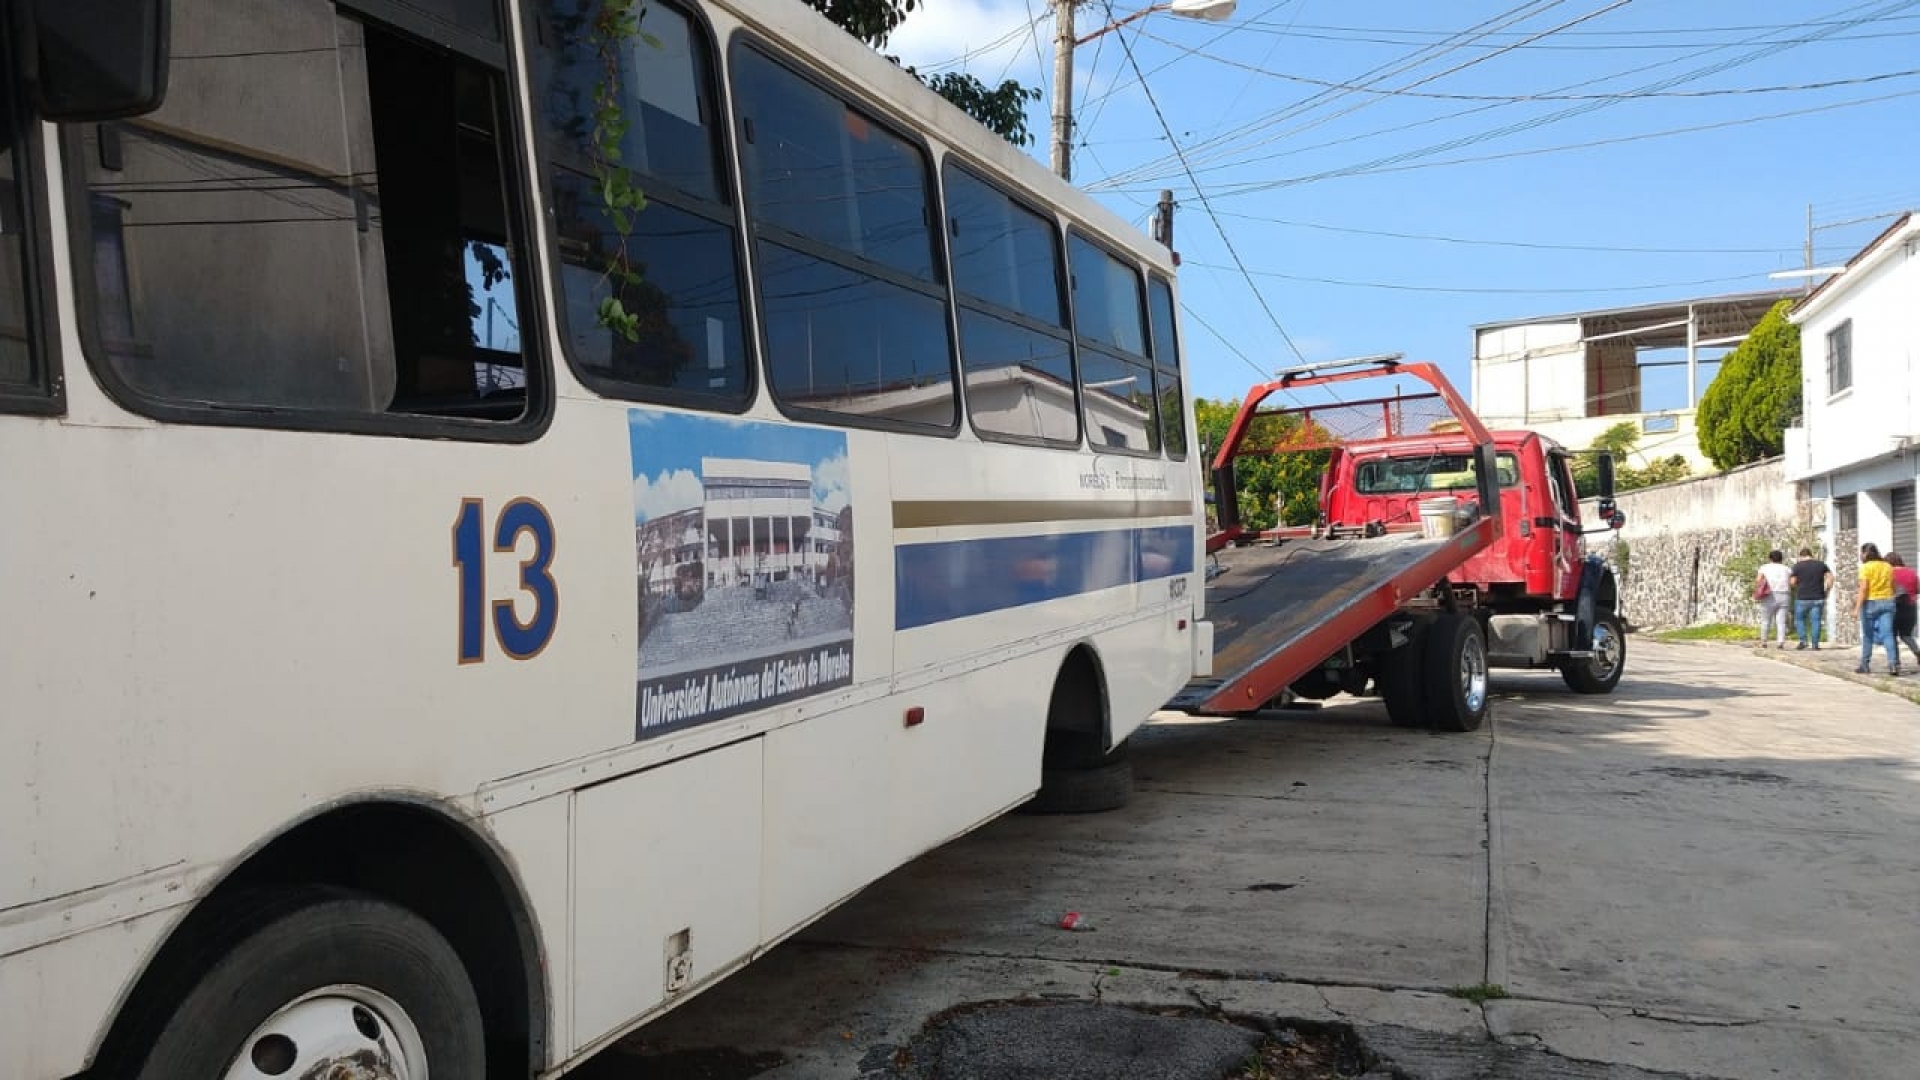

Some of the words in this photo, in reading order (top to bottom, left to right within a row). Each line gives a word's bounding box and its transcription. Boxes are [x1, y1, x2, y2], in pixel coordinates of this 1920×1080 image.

[452, 497, 559, 665] 13
[641, 676, 709, 728] Universidad
[709, 667, 760, 712] Autónoma
[761, 661, 777, 700] del
[777, 655, 806, 695] Estado
[807, 653, 818, 687] de
[819, 647, 850, 682] Morelos
